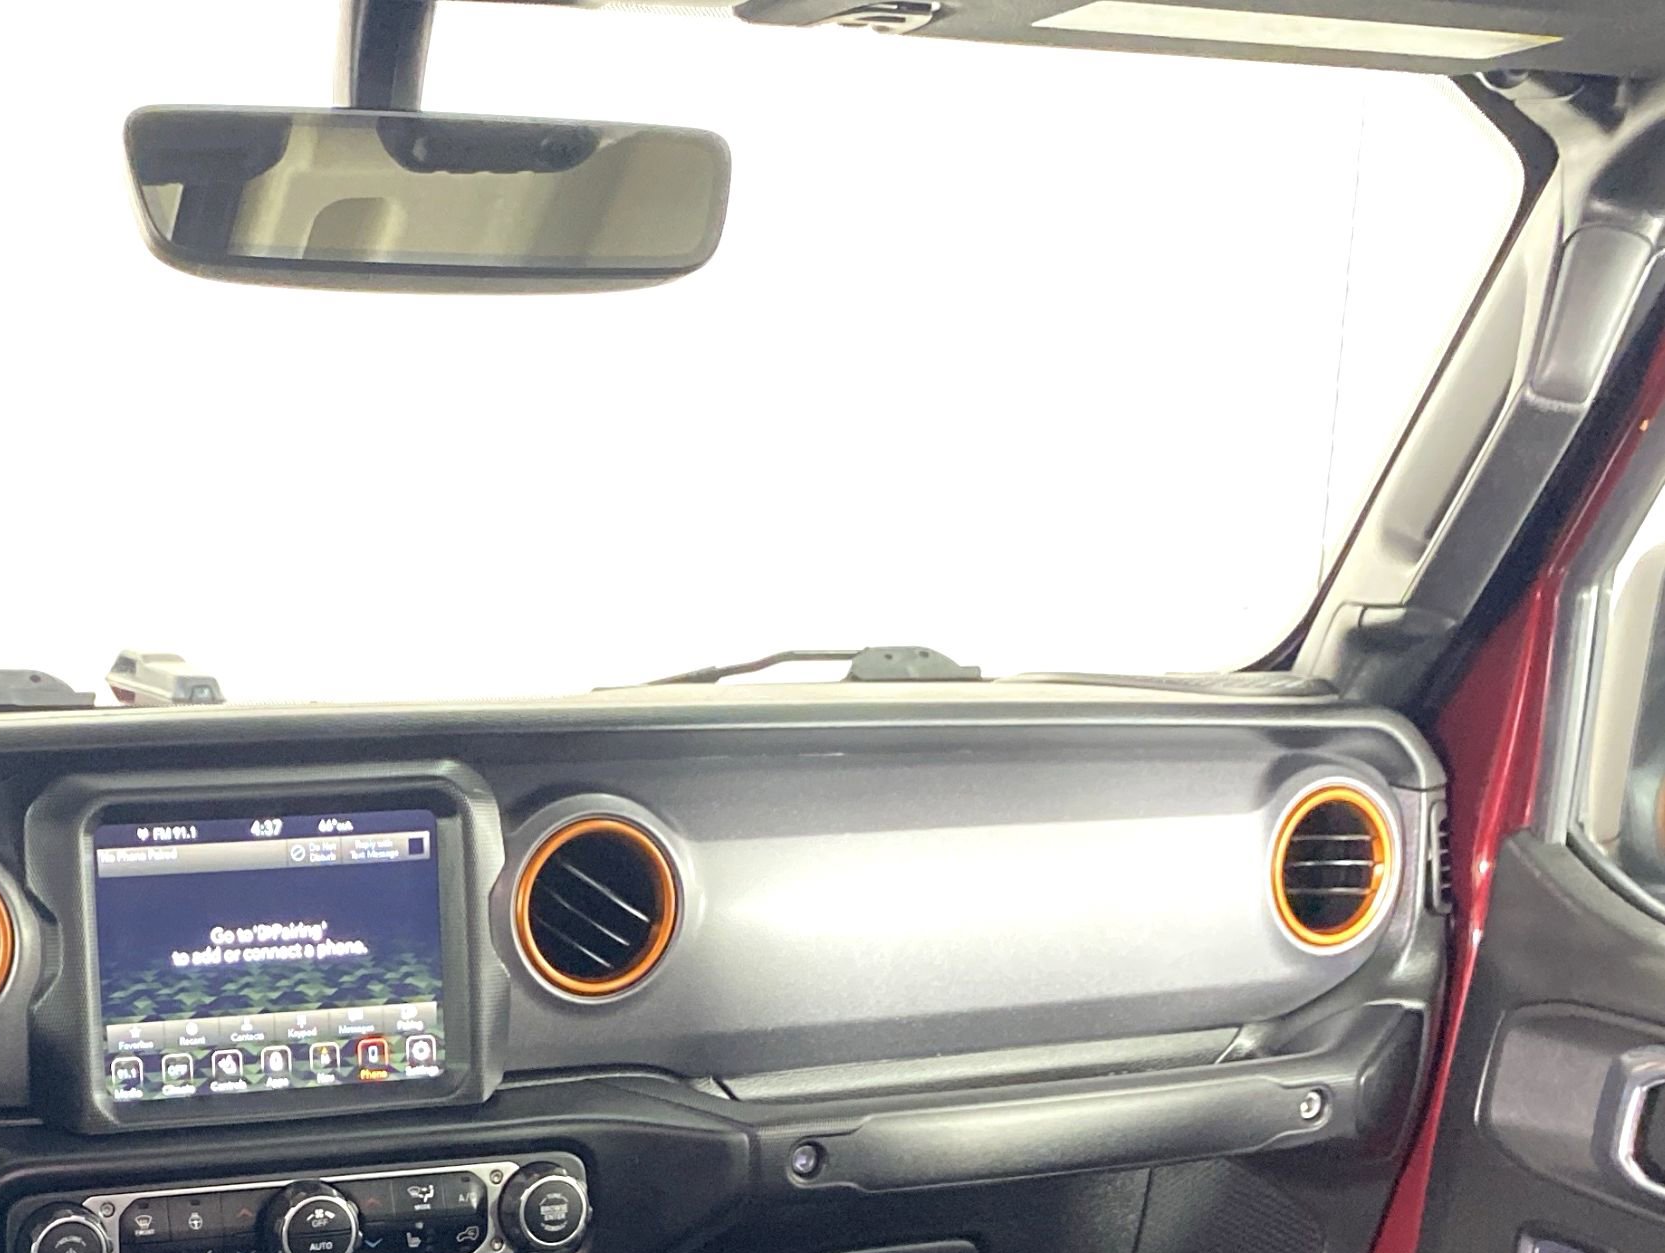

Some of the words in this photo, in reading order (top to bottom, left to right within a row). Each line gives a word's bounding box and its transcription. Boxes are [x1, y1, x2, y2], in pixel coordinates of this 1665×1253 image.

[153, 826, 172, 840] FM
[172, 825, 196, 840] 91.1
[250, 819, 282, 837] 4:37
[210, 926, 235, 944] Go
[236, 927, 253, 943] to
[171, 950, 190, 966] to
[192, 945, 221, 965] add
[223, 949, 241, 963] or
[243, 943, 302, 962] connect
[360, 1068, 388, 1081] Phone
[309, 1241, 333, 1251] AUTO
